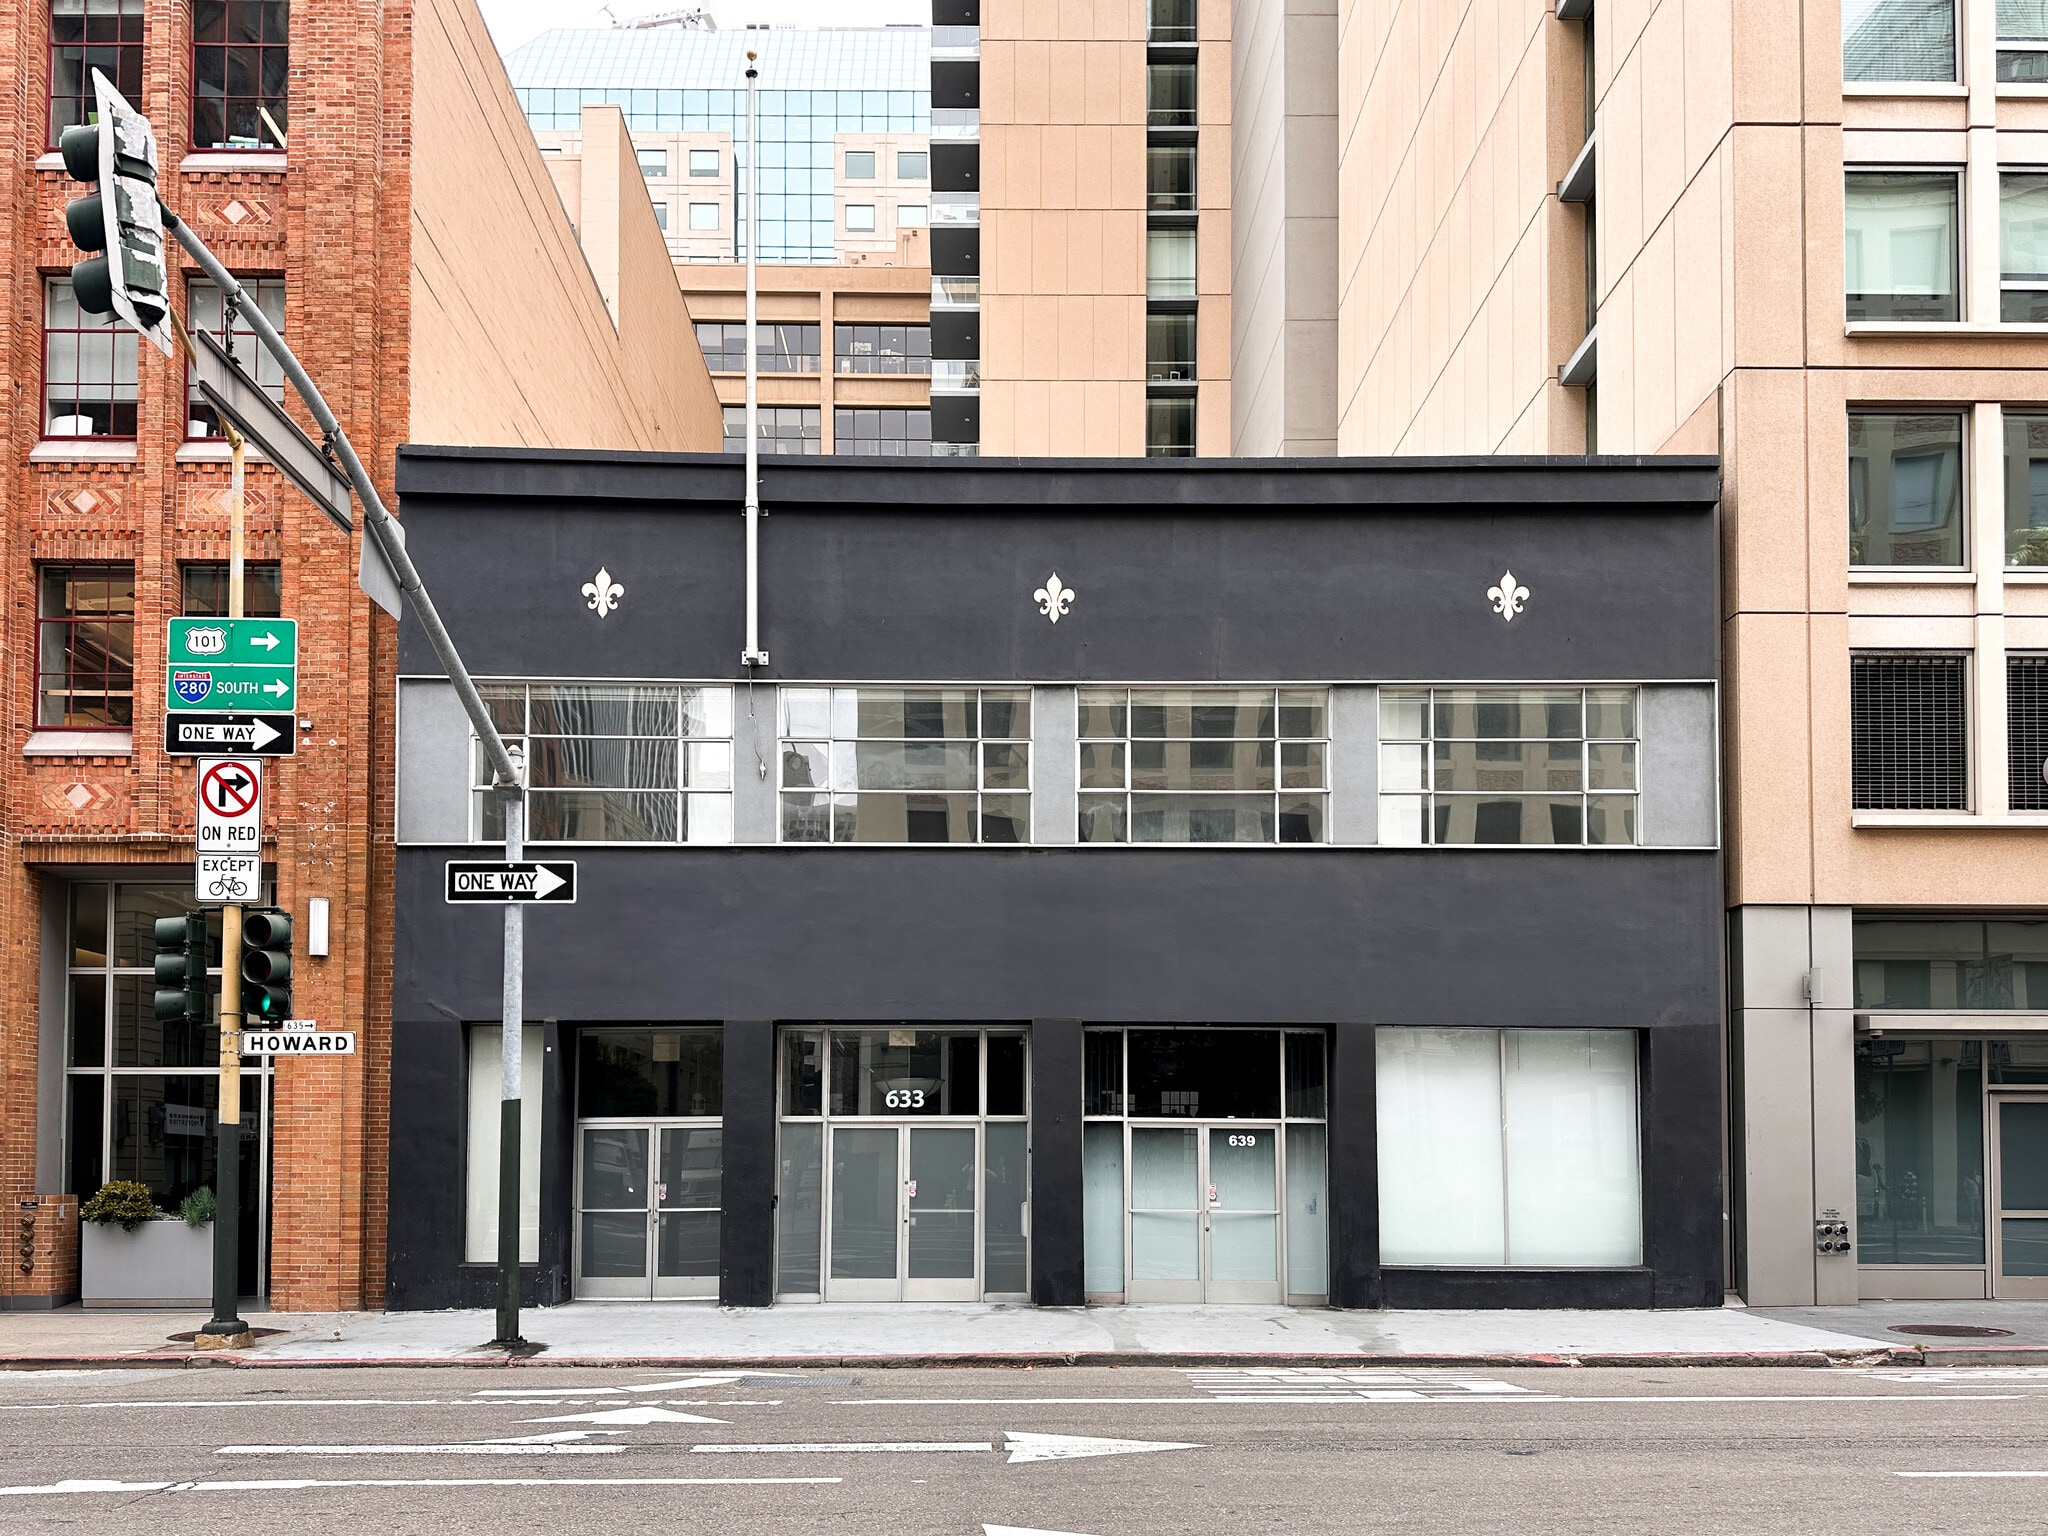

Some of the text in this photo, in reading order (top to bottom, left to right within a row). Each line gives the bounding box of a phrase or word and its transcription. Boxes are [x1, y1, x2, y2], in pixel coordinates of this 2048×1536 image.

[194, 636, 215, 647] 101
[179, 682, 258, 694] 280 SOUTH
[182, 726, 256, 740] ONE WAY
[202, 825, 256, 841] ON RED
[203, 859, 255, 872] EXCEPT
[458, 873, 538, 890] ONE WAY
[287, 1021, 304, 1030] 635
[250, 1036, 348, 1051] HOWARD
[885, 1089, 925, 1108] 633
[1228, 1134, 1256, 1147] 639
